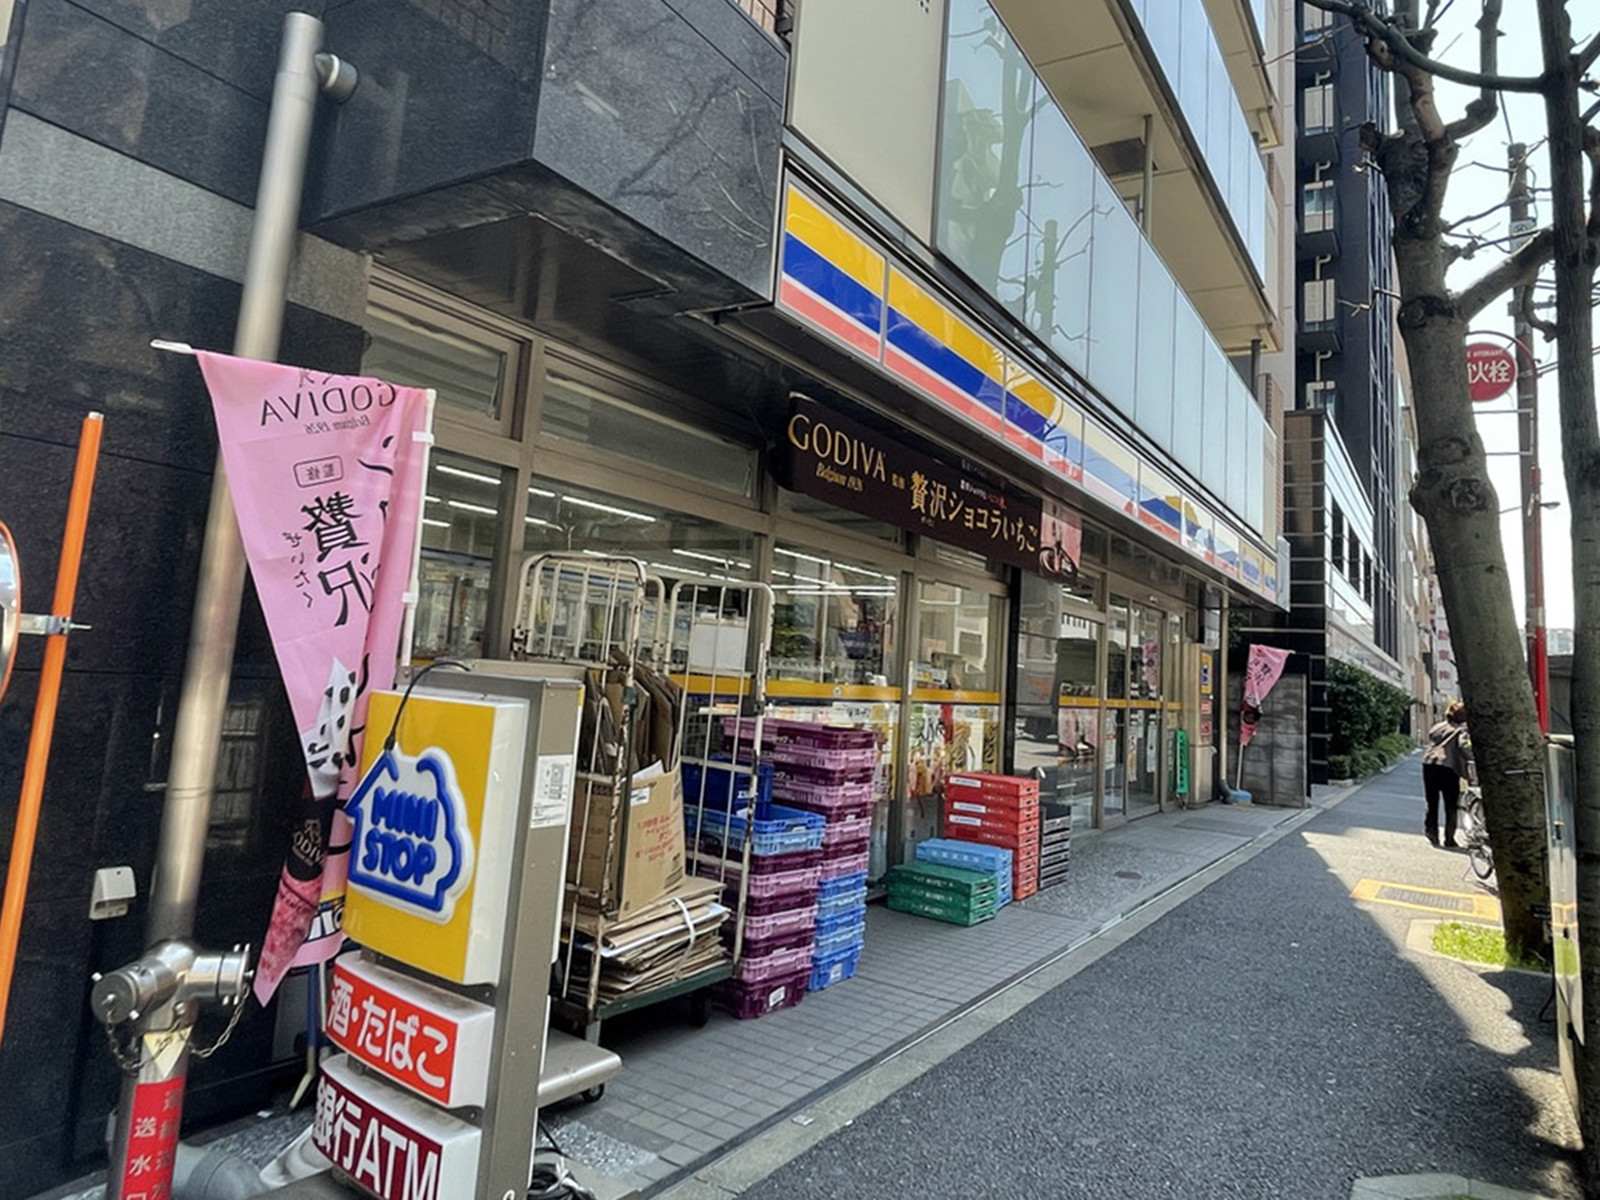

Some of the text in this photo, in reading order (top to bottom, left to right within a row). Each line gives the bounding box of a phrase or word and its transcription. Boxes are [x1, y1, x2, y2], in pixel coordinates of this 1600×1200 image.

[1467, 360, 1510, 383] 火栓
[787, 414, 885, 482] GODIVA
[910, 470, 1038, 552] 贅沢ショコラいちご
[371, 786, 438, 842] MINI
[363, 828, 437, 886] STOP
[328, 974, 448, 1088] 酒・たばこ
[313, 1075, 439, 1200] 銀行ATM
